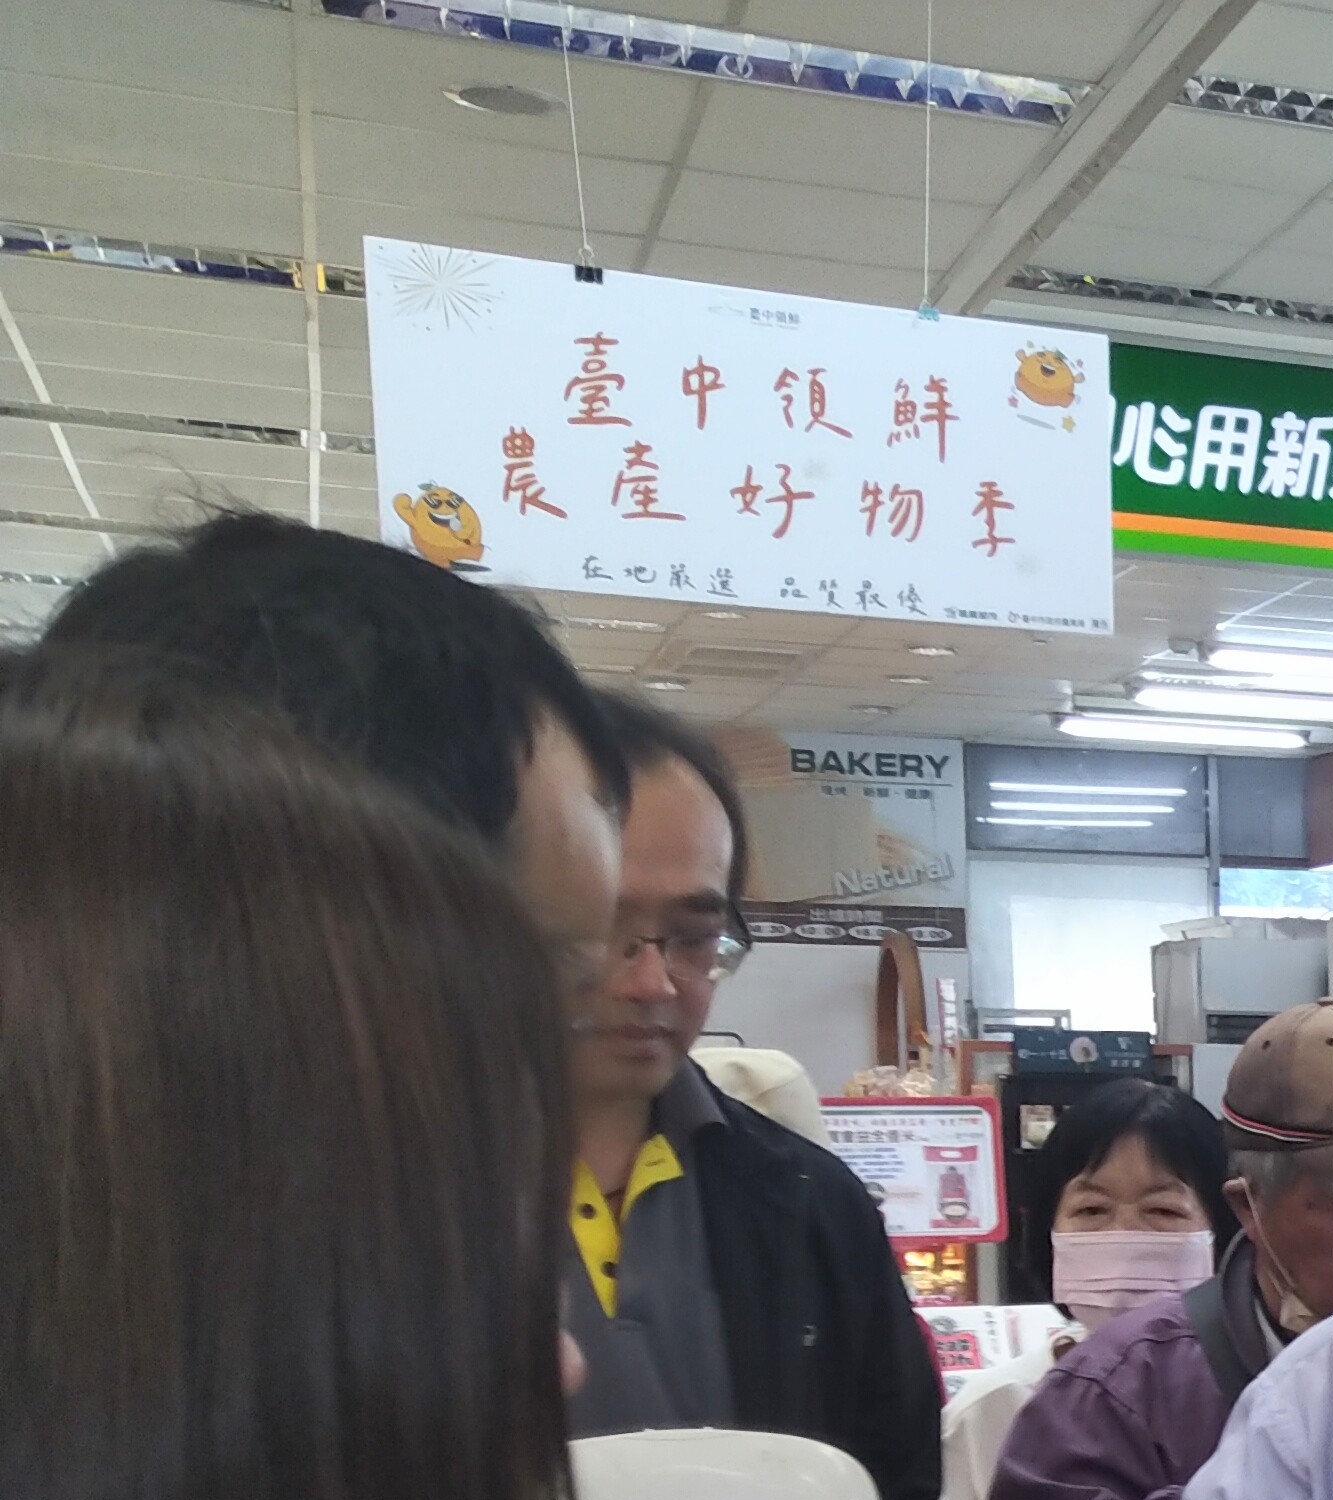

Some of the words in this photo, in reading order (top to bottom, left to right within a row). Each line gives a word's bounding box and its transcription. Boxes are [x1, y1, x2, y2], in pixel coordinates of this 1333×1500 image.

[563, 332, 960, 463] 臺中領鮮
[501, 426, 1017, 558] 農產好物季
[790, 748, 950, 779] BAKERY
[831, 853, 955, 897] Natural
